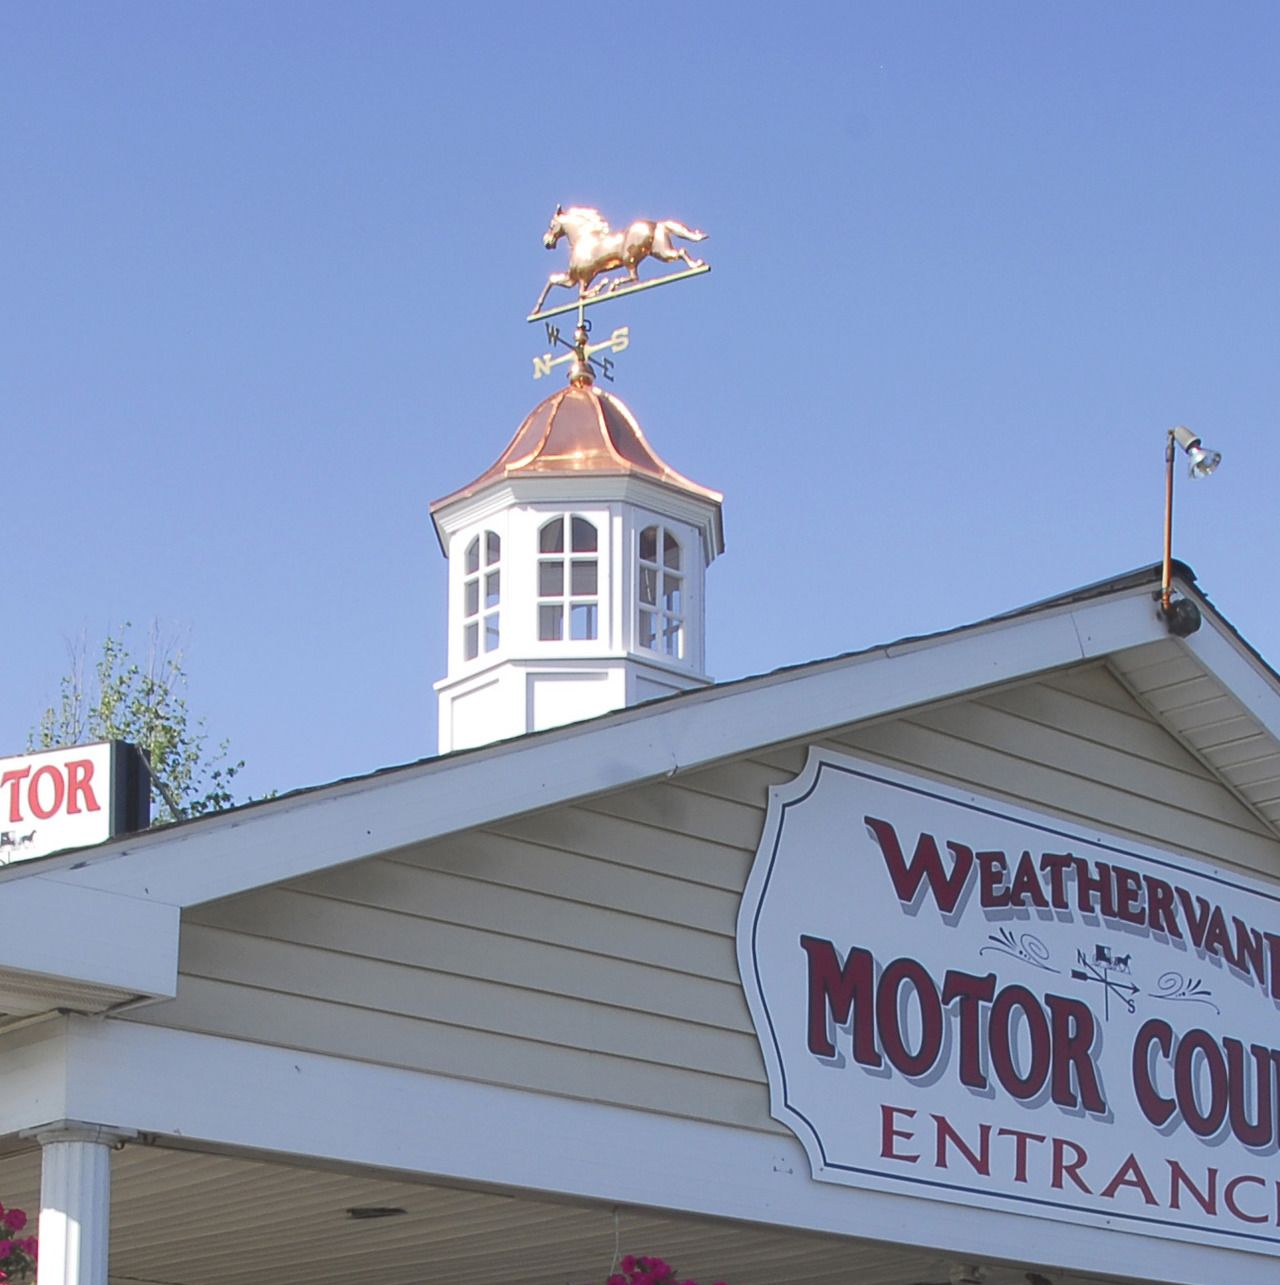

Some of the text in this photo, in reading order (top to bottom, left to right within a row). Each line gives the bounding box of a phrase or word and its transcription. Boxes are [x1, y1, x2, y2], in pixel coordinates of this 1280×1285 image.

[611, 326, 629, 353] S
[532, 353, 552, 379] N
[800, 935, 1108, 1116] MOTOR
